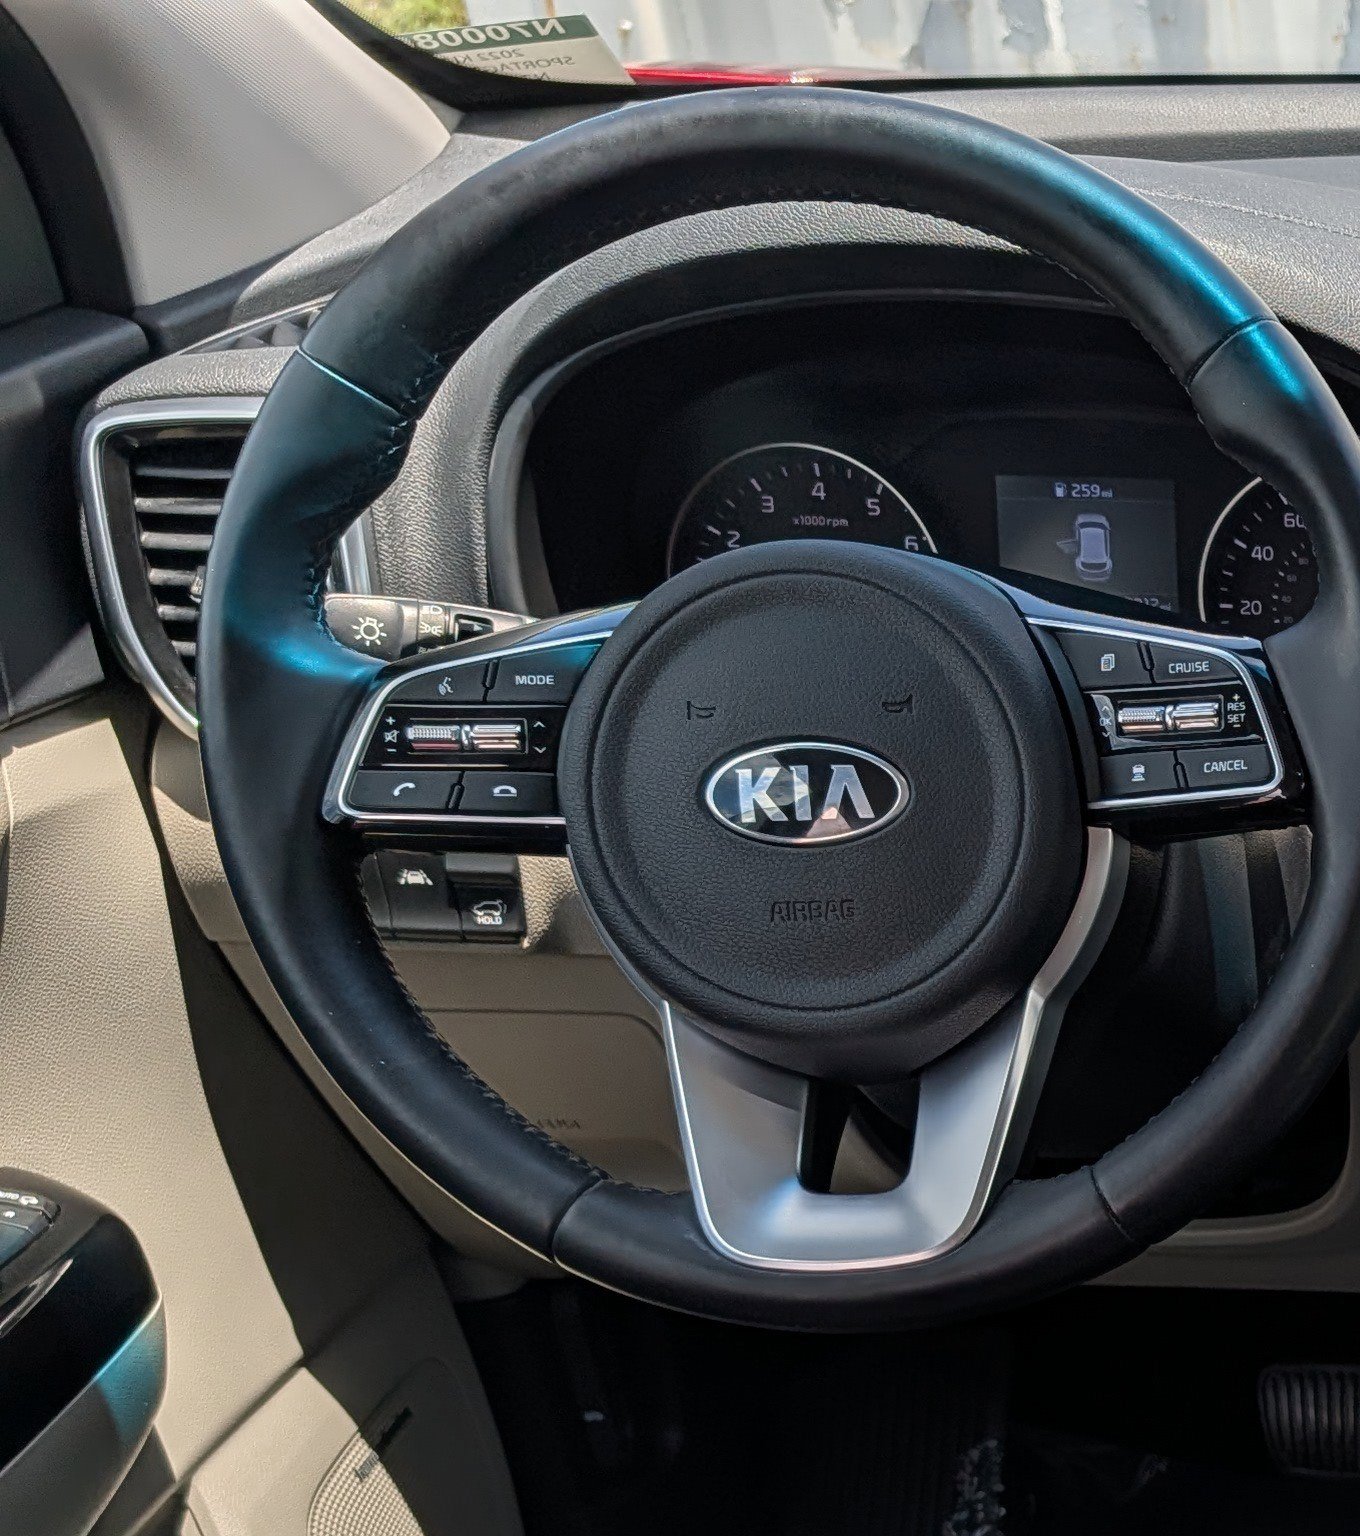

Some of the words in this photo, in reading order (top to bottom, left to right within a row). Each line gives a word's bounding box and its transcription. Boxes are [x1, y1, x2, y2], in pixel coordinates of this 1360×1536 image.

[811, 482, 826, 500] 4
[1071, 483, 1100, 498] 259
[761, 496, 775, 513] 3
[865, 498, 881, 516] 5
[727, 531, 741, 548] 2
[1251, 545, 1274, 561] 40
[1240, 600, 1262, 616] 20
[1168, 660, 1210, 674] CRUISE
[515, 675, 555, 685] MODE
[1226, 702, 1246, 711] RES
[1226, 713, 1246, 723] SET
[1203, 759, 1248, 773] CANCEL
[735, 764, 875, 823] KIA
[477, 916, 503, 925] HOLD
